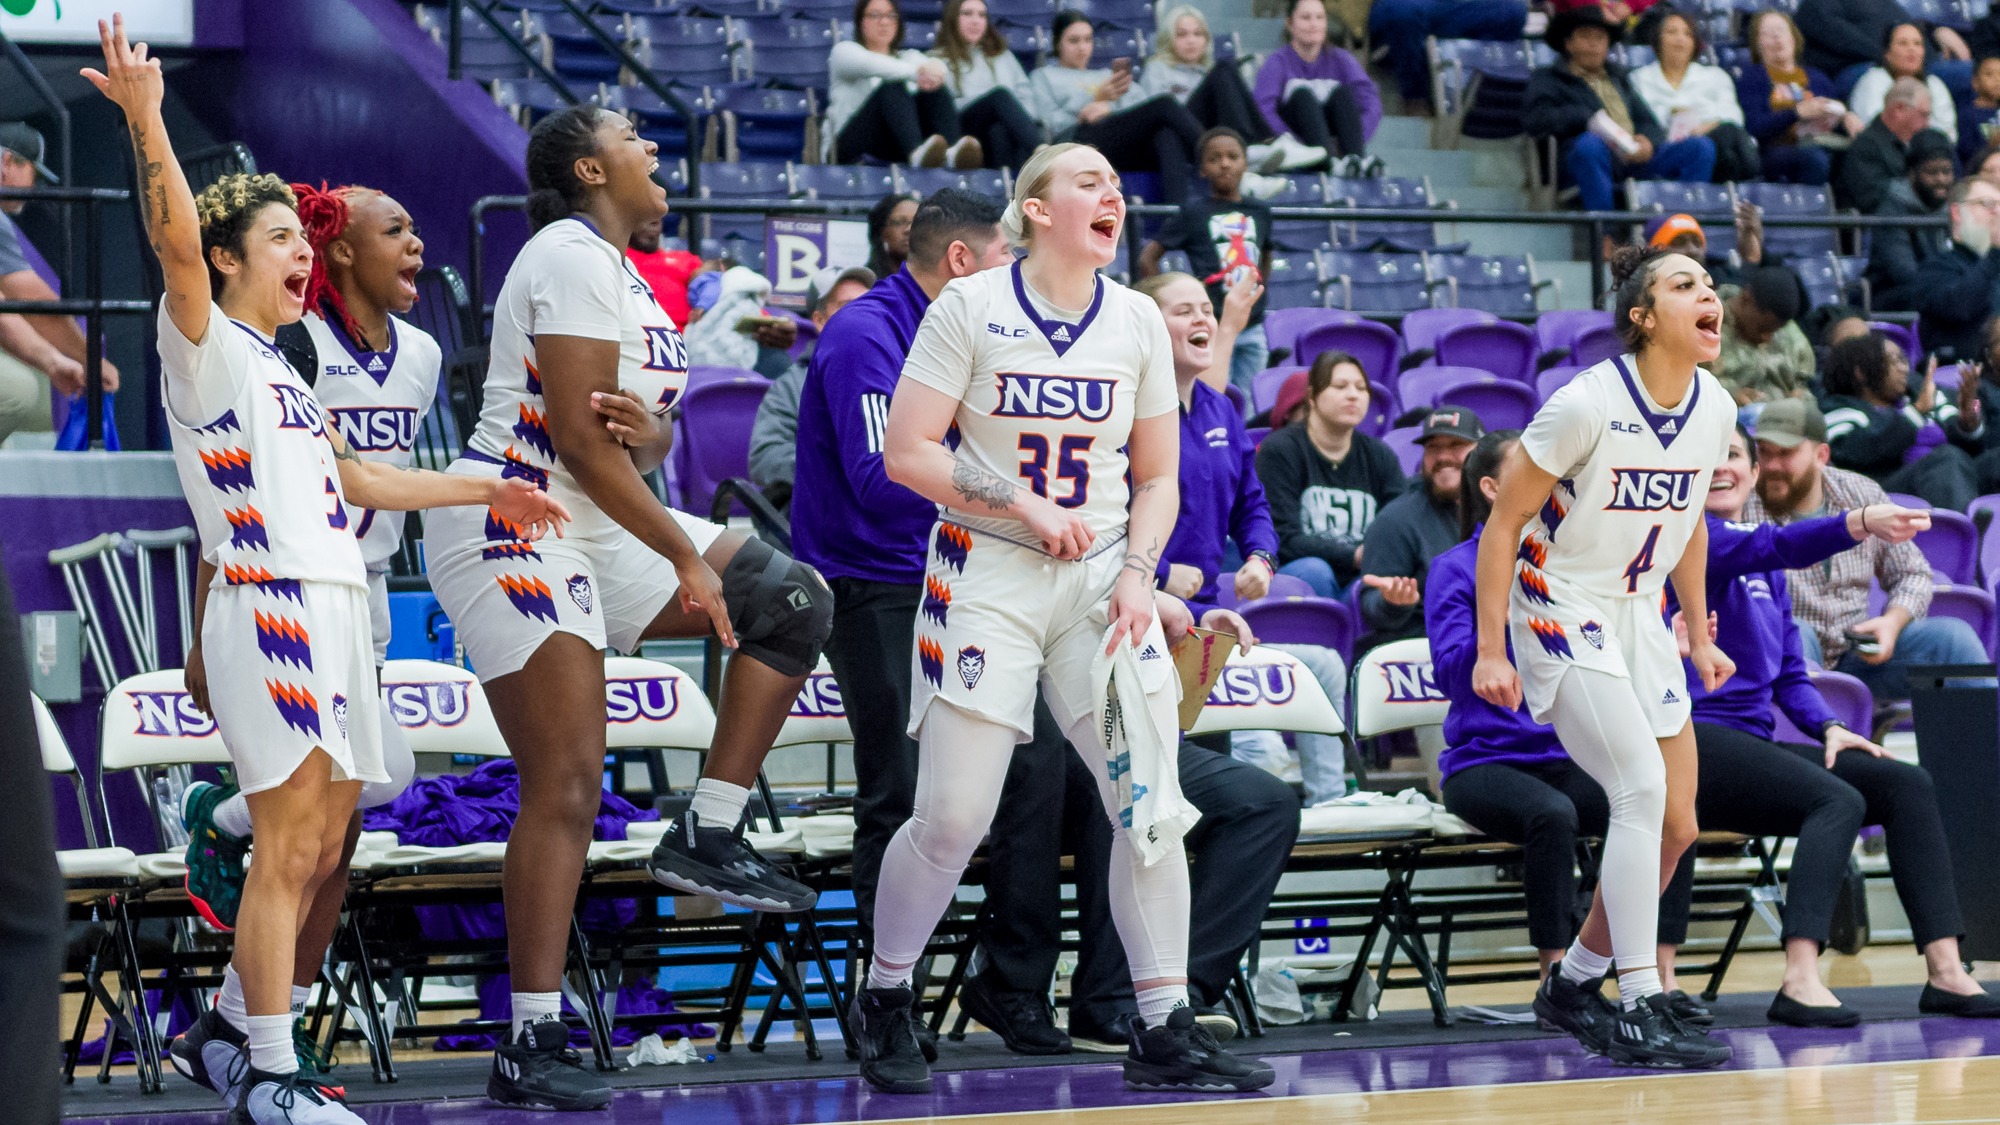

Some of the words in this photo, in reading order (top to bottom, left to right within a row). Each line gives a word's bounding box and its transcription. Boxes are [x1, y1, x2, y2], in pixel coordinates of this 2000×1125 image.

[773, 221, 795, 232] THE
[795, 222, 823, 234] CORE
[774, 233, 822, 292] B
[987, 322, 1028, 338] SLC
[650, 330, 688, 369] NS
[325, 365, 358, 376] SLC
[1000, 375, 1113, 419] NSU
[336, 410, 418, 448] NSU
[1610, 420, 1642, 434] SLC
[1017, 431, 1097, 509] 35
[1613, 471, 1695, 509] NSU
[1622, 523, 1664, 594] 4
[605, 679, 673, 718] SU
[790, 677, 845, 713] NS
[1386, 664, 1446, 699] NS
[136, 694, 215, 734] NS
